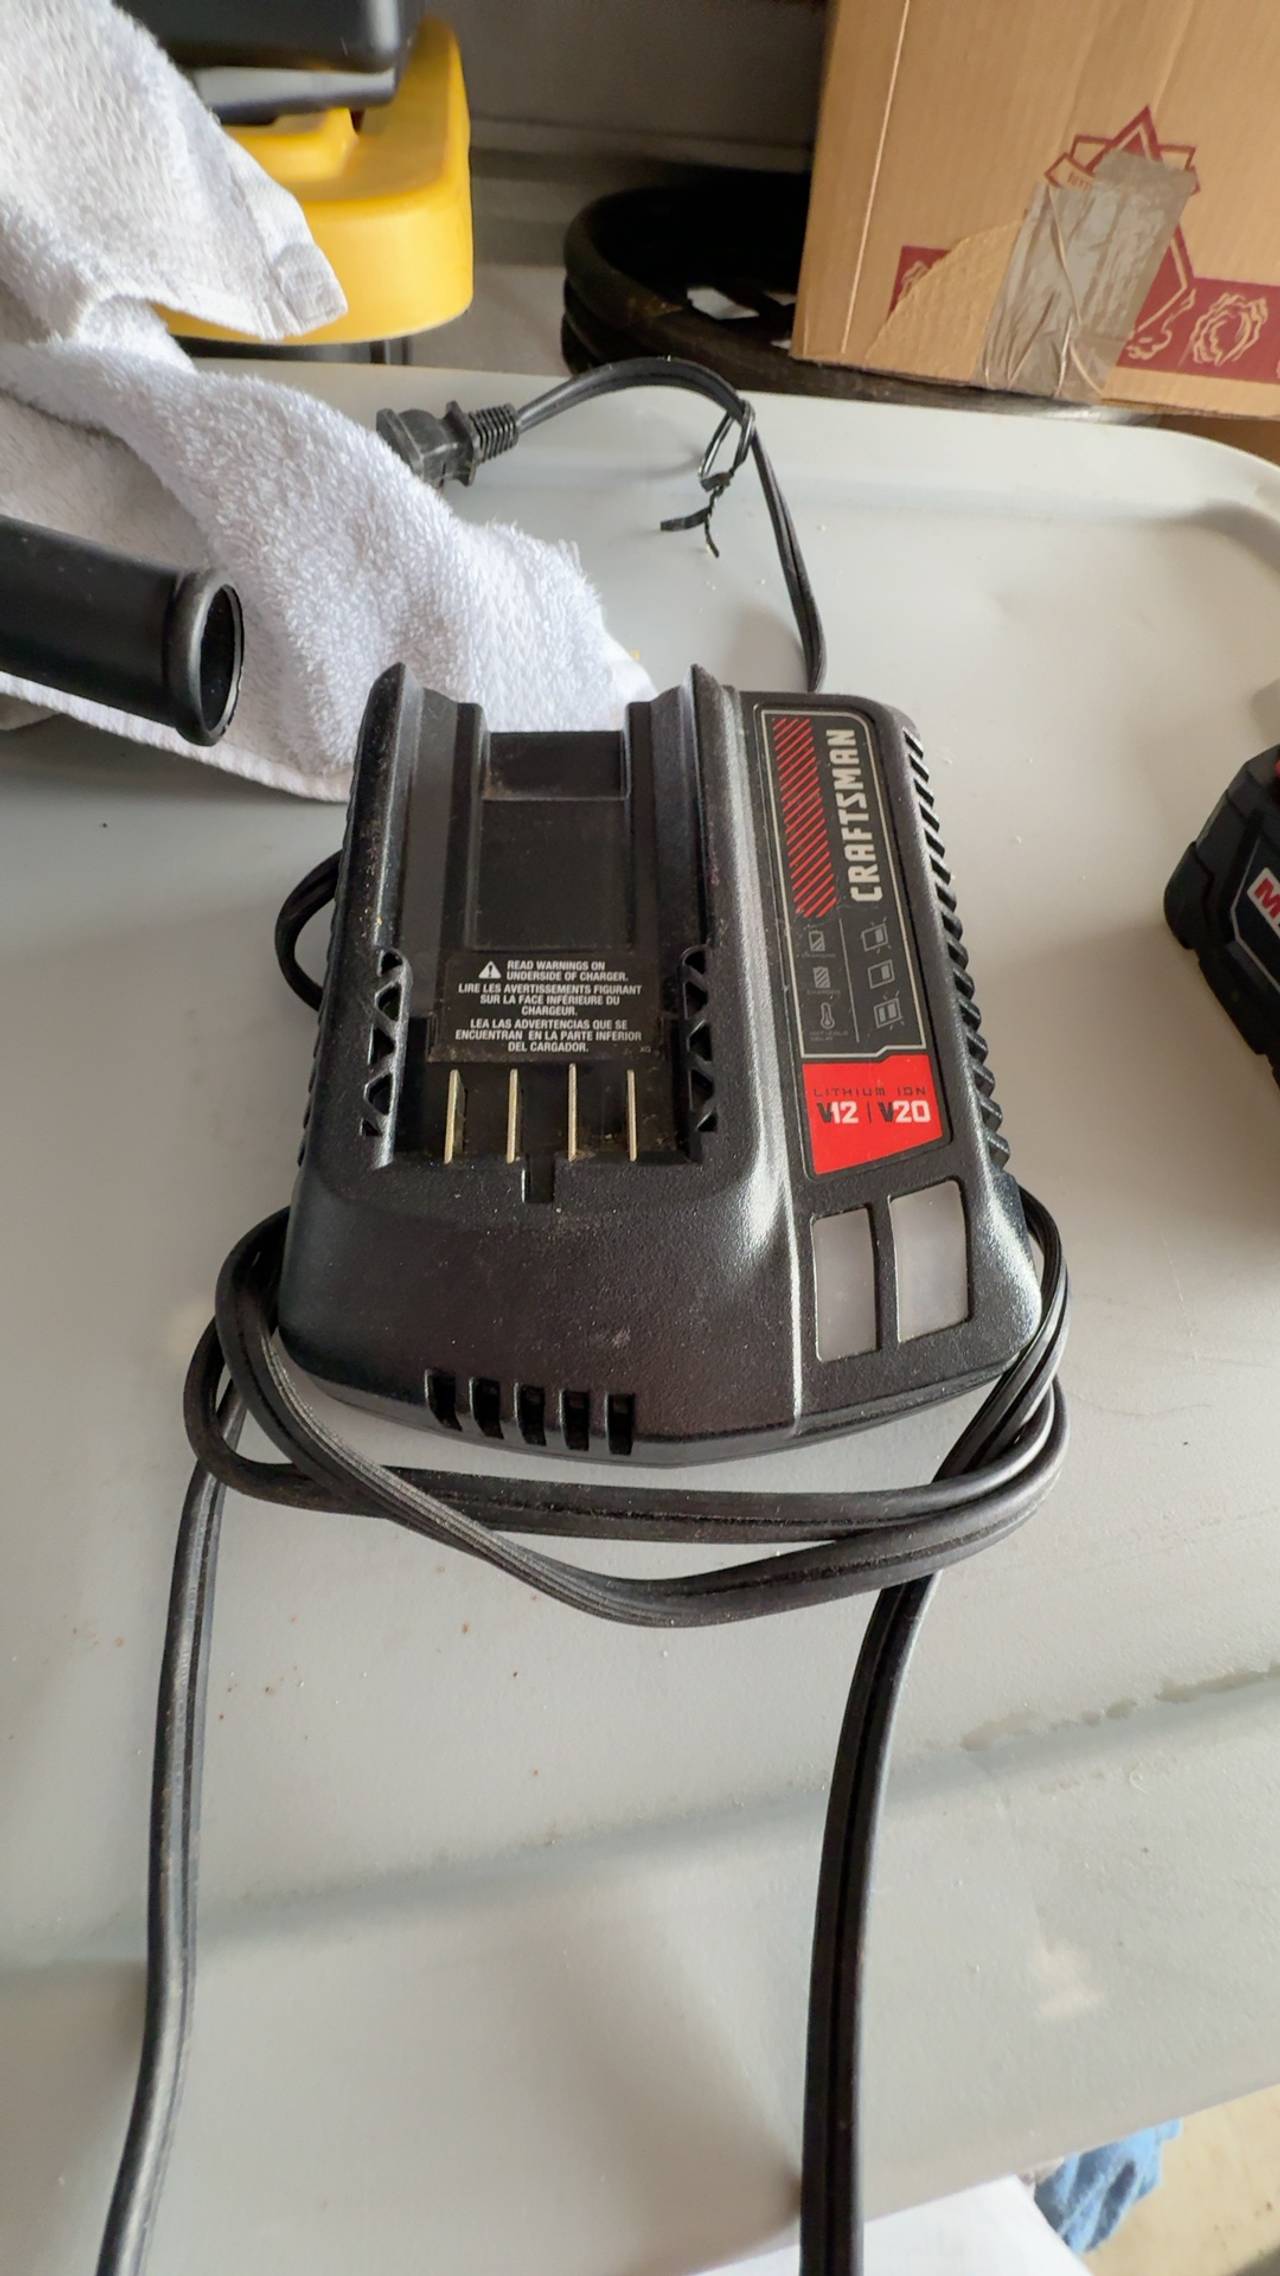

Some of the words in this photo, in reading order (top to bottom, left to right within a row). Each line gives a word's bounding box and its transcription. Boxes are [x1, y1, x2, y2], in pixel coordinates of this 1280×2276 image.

[826, 730, 883, 901] CRAFTSMAN
[507, 960, 533, 970] READ
[536, 961, 589, 970] WARNINGS
[591, 961, 605, 970] ON
[507, 971, 562, 981] UNDERSIDE
[564, 972, 577, 981] OF
[580, 972, 628, 981] CHARGER.
[458, 983, 480, 993] LIRE
[483, 983, 501, 993] LES
[504, 984, 591, 994] AVERTISSEMENTS
[594, 984, 642, 995] FIGURANT
[480, 995, 500, 1004] SUR
[503, 995, 516, 1004] LA
[519, 995, 544, 1004] FACE
[547, 994, 603, 1005] INFÉRIEURE
[606, 996, 620, 1005] DU
[521, 1006, 577, 1016] CHARGEUR.
[470, 1019, 490, 1029] LEA
[493, 1019, 512, 1029] LAS
[515, 1019, 589, 1030] ADVERTENCIAS
[592, 1020, 612, 1030] QUE
[615, 1020, 628, 1030] SE
[455, 1030, 523, 1041] ENCUENTRAN
[529, 1031, 542, 1041] EN
[545, 1031, 558, 1041] LA
[560, 1031, 592, 1041] PARTE
[595, 1031, 641, 1041] INFERIOR
[508, 1042, 527, 1052] DEL
[530, 1042, 589, 1052] CARGADOR.
[814, 1088, 885, 1096] LITHIUM
[897, 1087, 926, 1096] ION
[817, 1101, 859, 1124] V12
[878, 1100, 931, 1123] V20
